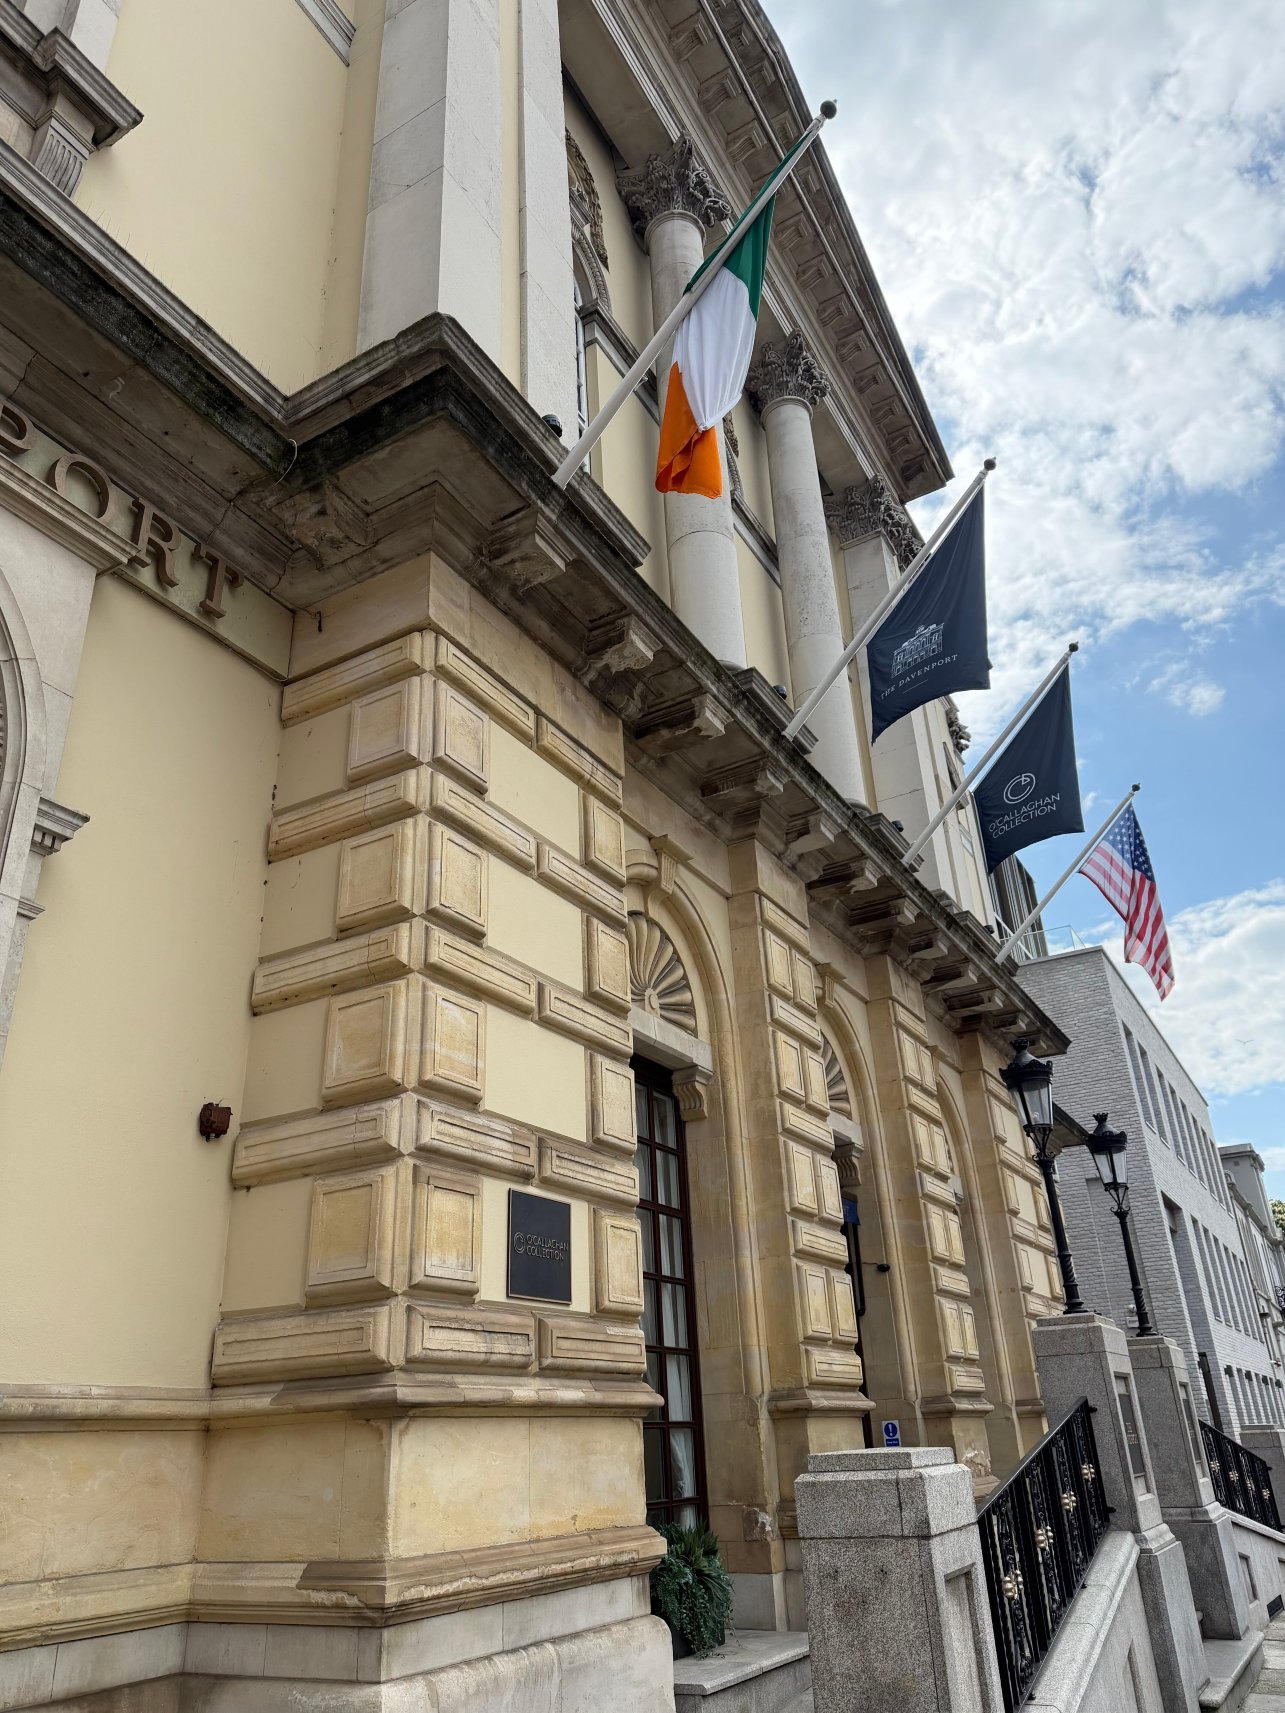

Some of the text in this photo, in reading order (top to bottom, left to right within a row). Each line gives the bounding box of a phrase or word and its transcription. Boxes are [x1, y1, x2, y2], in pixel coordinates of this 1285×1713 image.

[881, 654, 958, 700] THE DAVENPORT
[988, 793, 1060, 832] O'CALLAGHAN
[992, 803, 1056, 839] COLLECTION
[526, 1245, 564, 1260] COLLECTION
